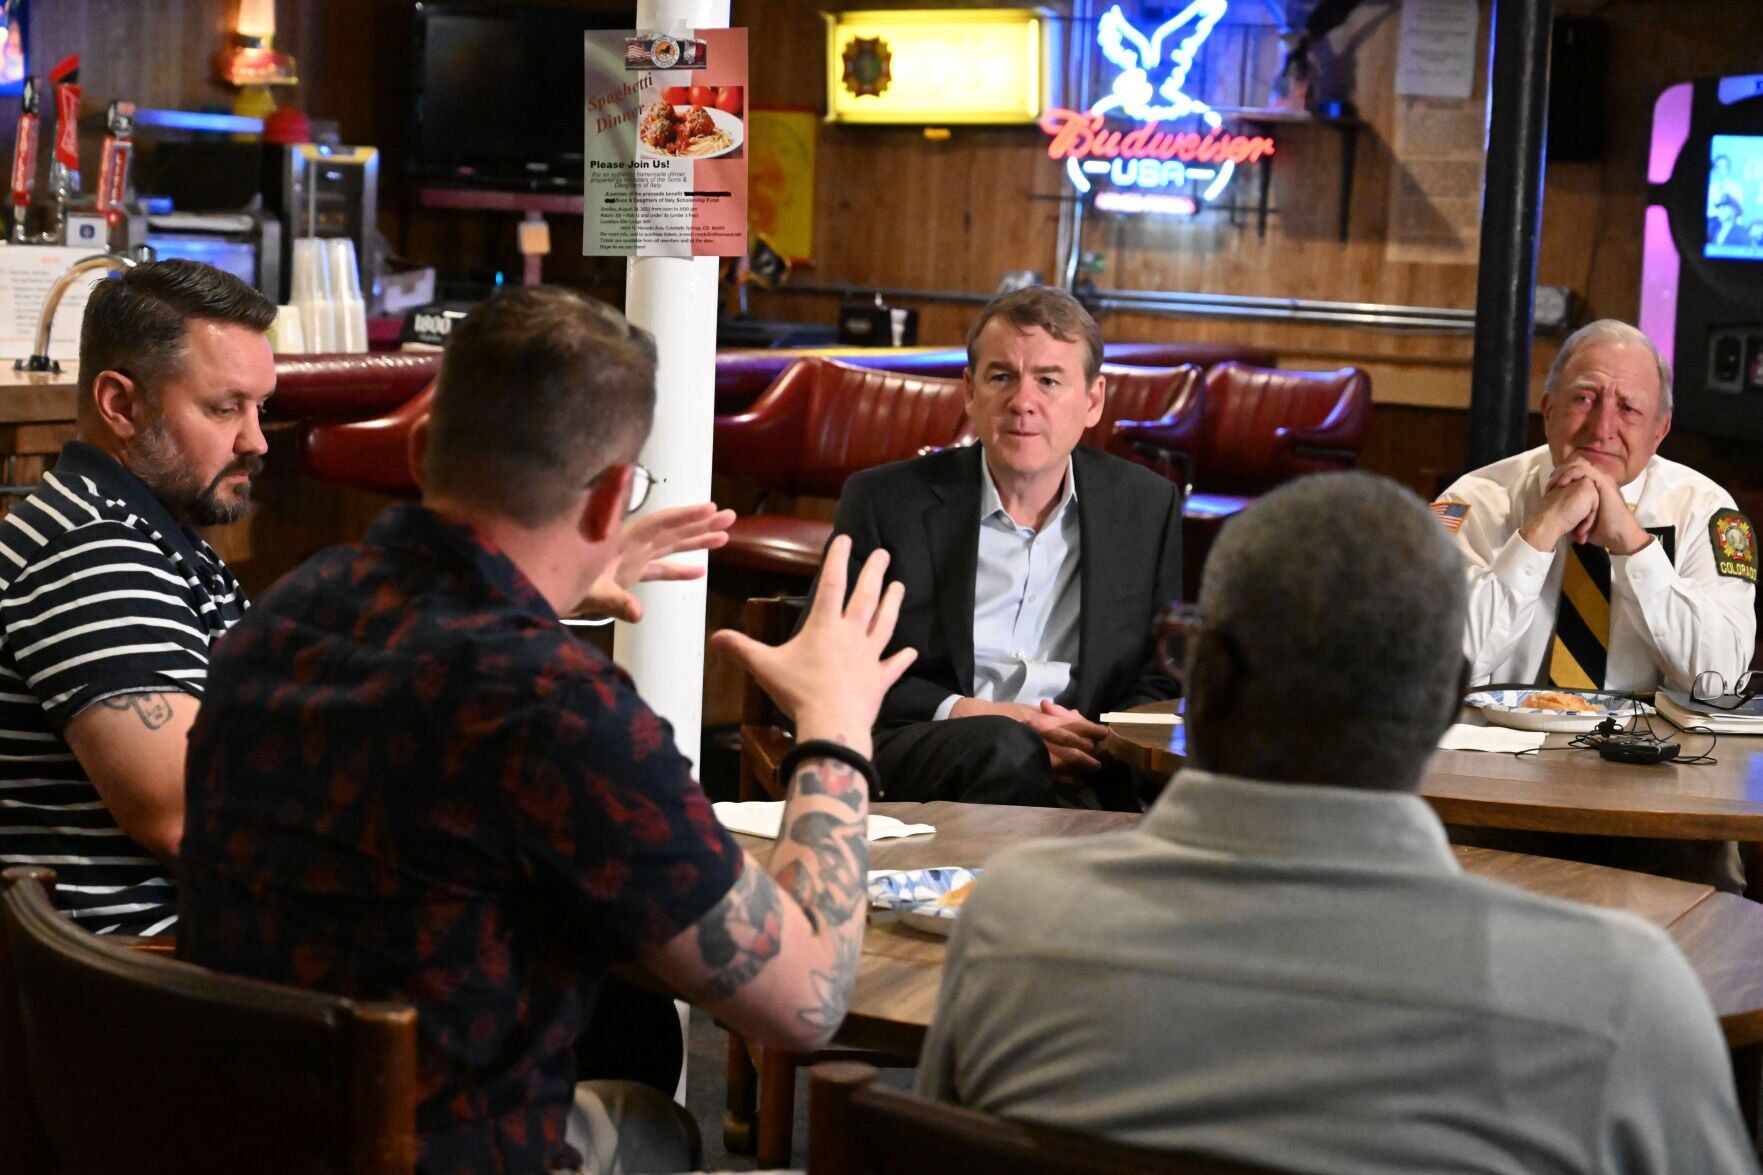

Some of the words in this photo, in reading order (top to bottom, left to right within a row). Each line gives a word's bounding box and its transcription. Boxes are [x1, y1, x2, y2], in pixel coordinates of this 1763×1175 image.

[588, 72, 654, 112] Spaghetti
[596, 103, 646, 134] Dinner
[1040, 108, 1275, 164] Budweiser
[590, 160, 625, 169] Please
[628, 160, 649, 169] Join
[652, 160, 670, 169] Us!
[1111, 158, 1185, 188] USA
[1720, 561, 1757, 581] COLORADO
